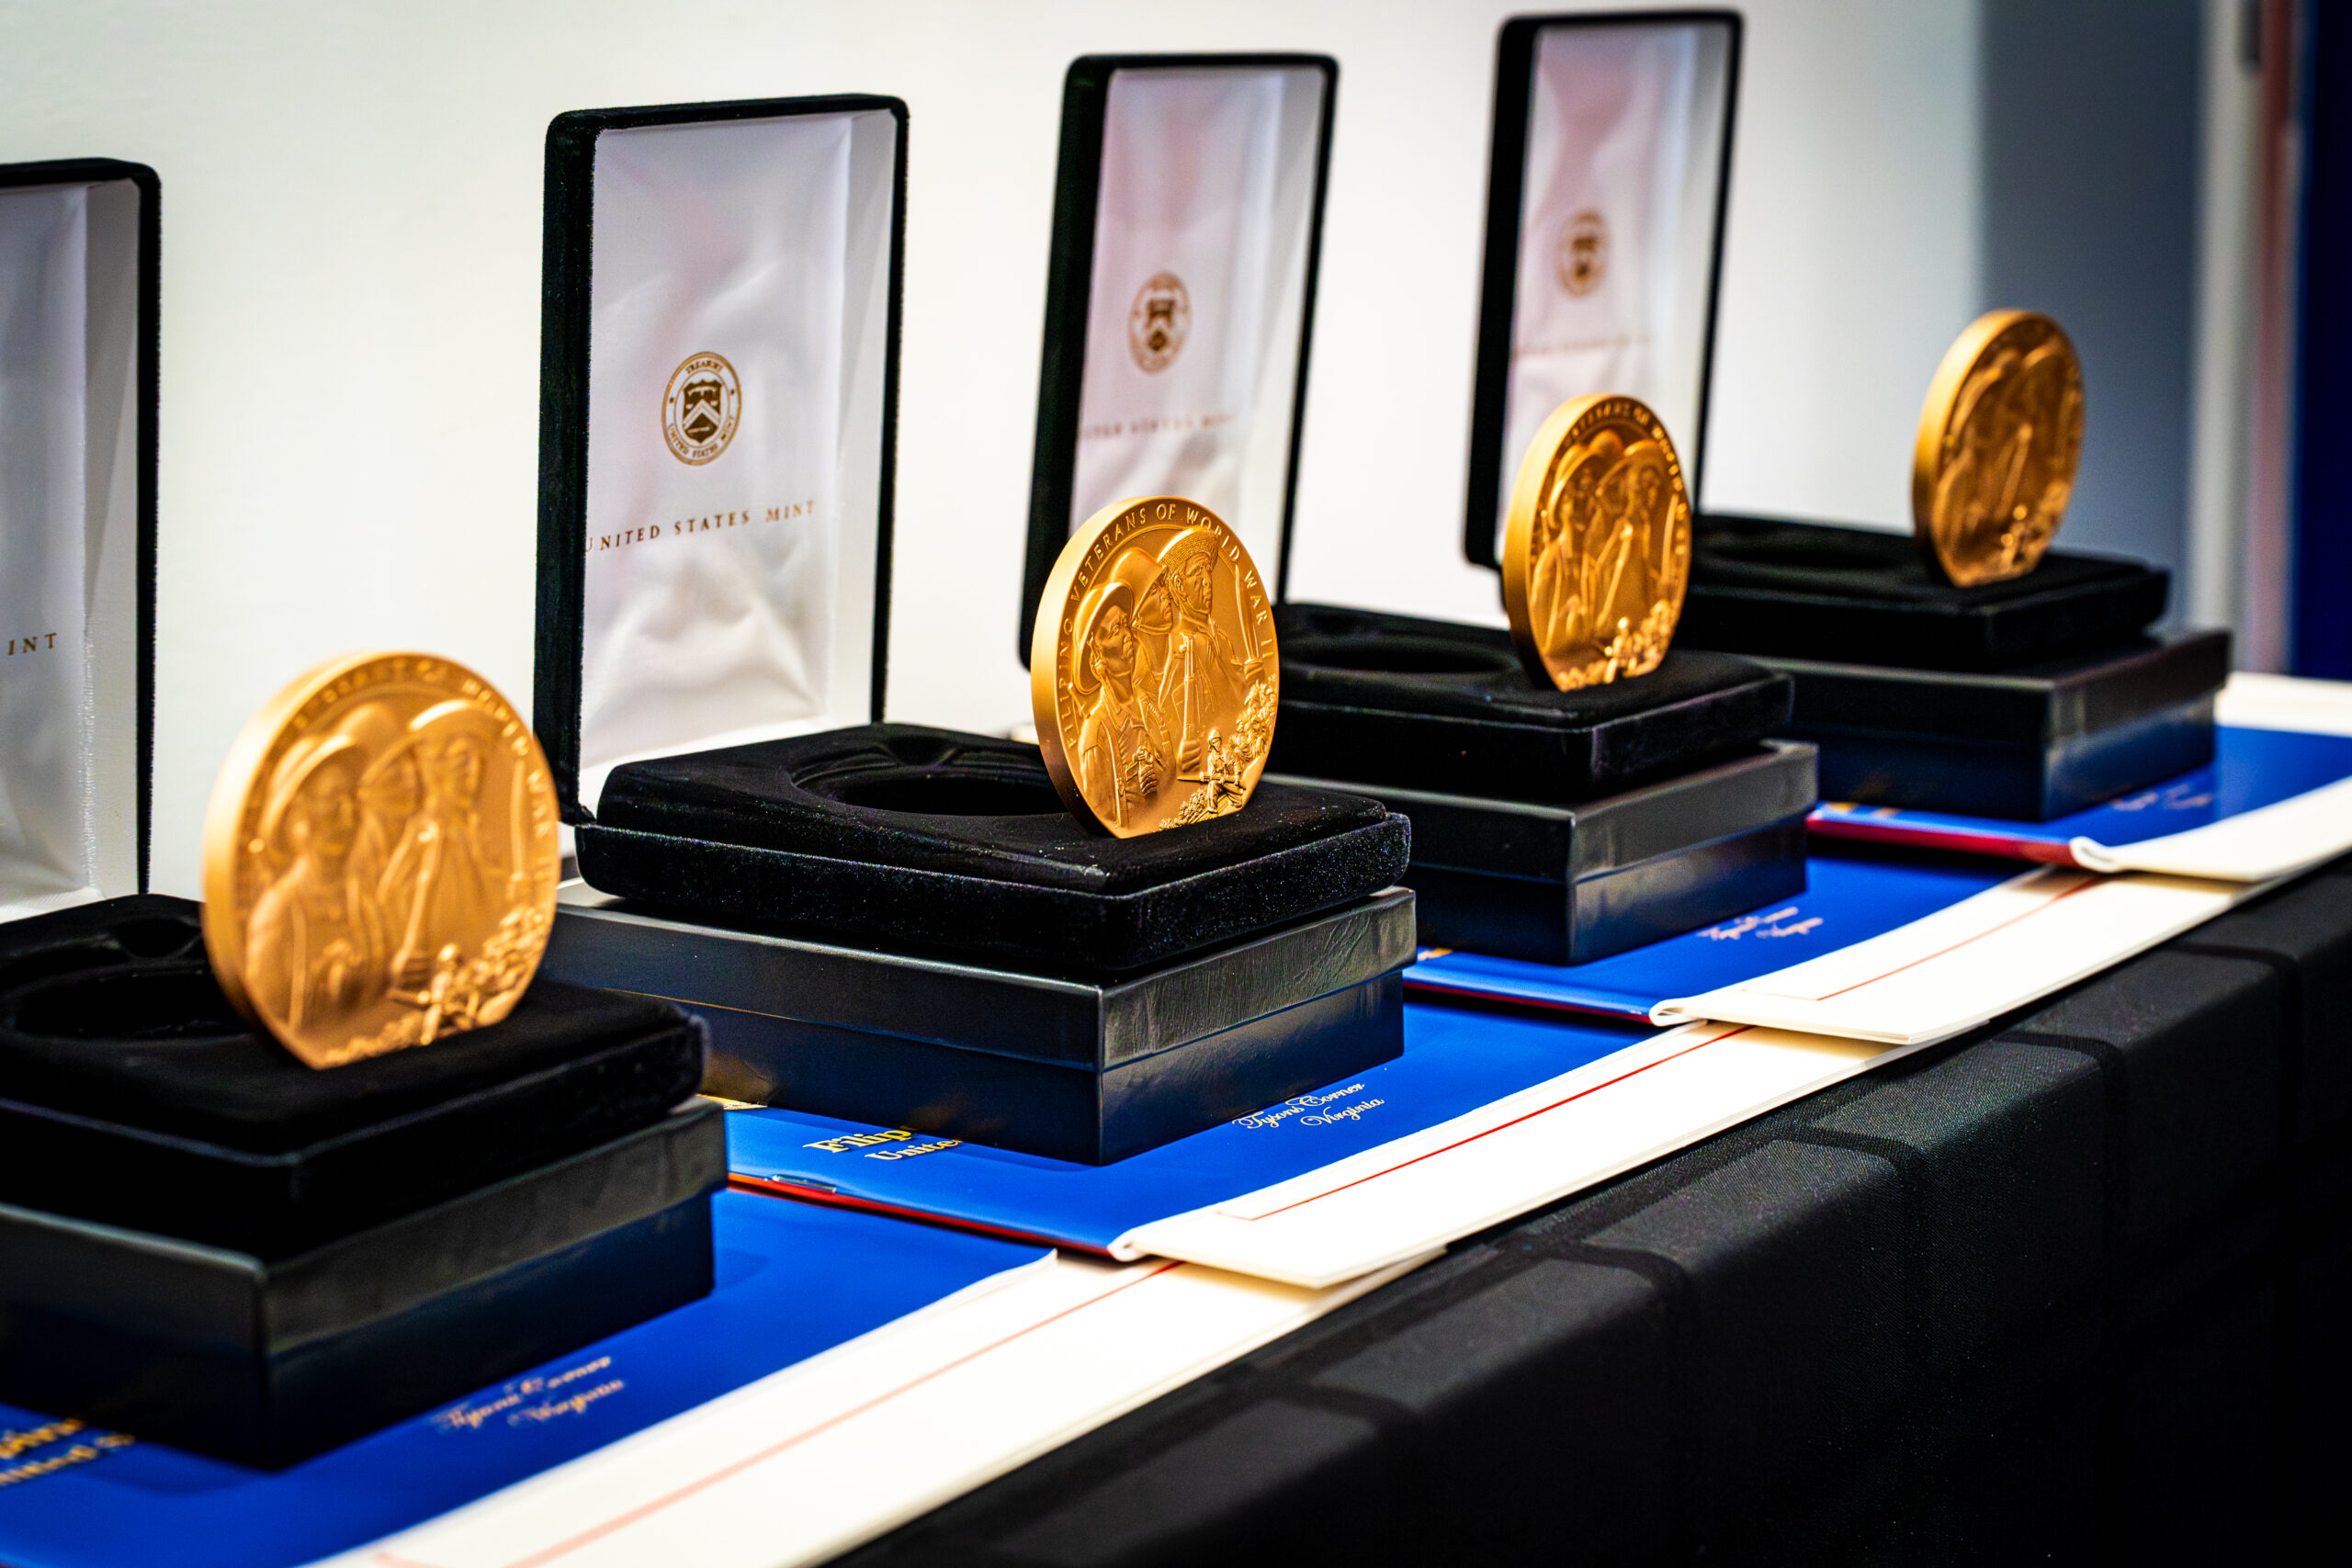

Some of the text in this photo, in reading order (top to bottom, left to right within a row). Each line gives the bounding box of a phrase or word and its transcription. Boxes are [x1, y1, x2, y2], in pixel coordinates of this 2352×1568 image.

[673, 510, 750, 536] STATES
[765, 500, 815, 523] MINT
[1070, 507, 1148, 604] VETERANS
[1156, 502, 1177, 520] OF
[1186, 506, 1240, 562] WORLD
[1243, 570, 1269, 626] WAR
[7, 632, 57, 656] INT
[1232, 1106, 1306, 1129] Tysons
[1300, 1099, 1385, 1124] Virginia
